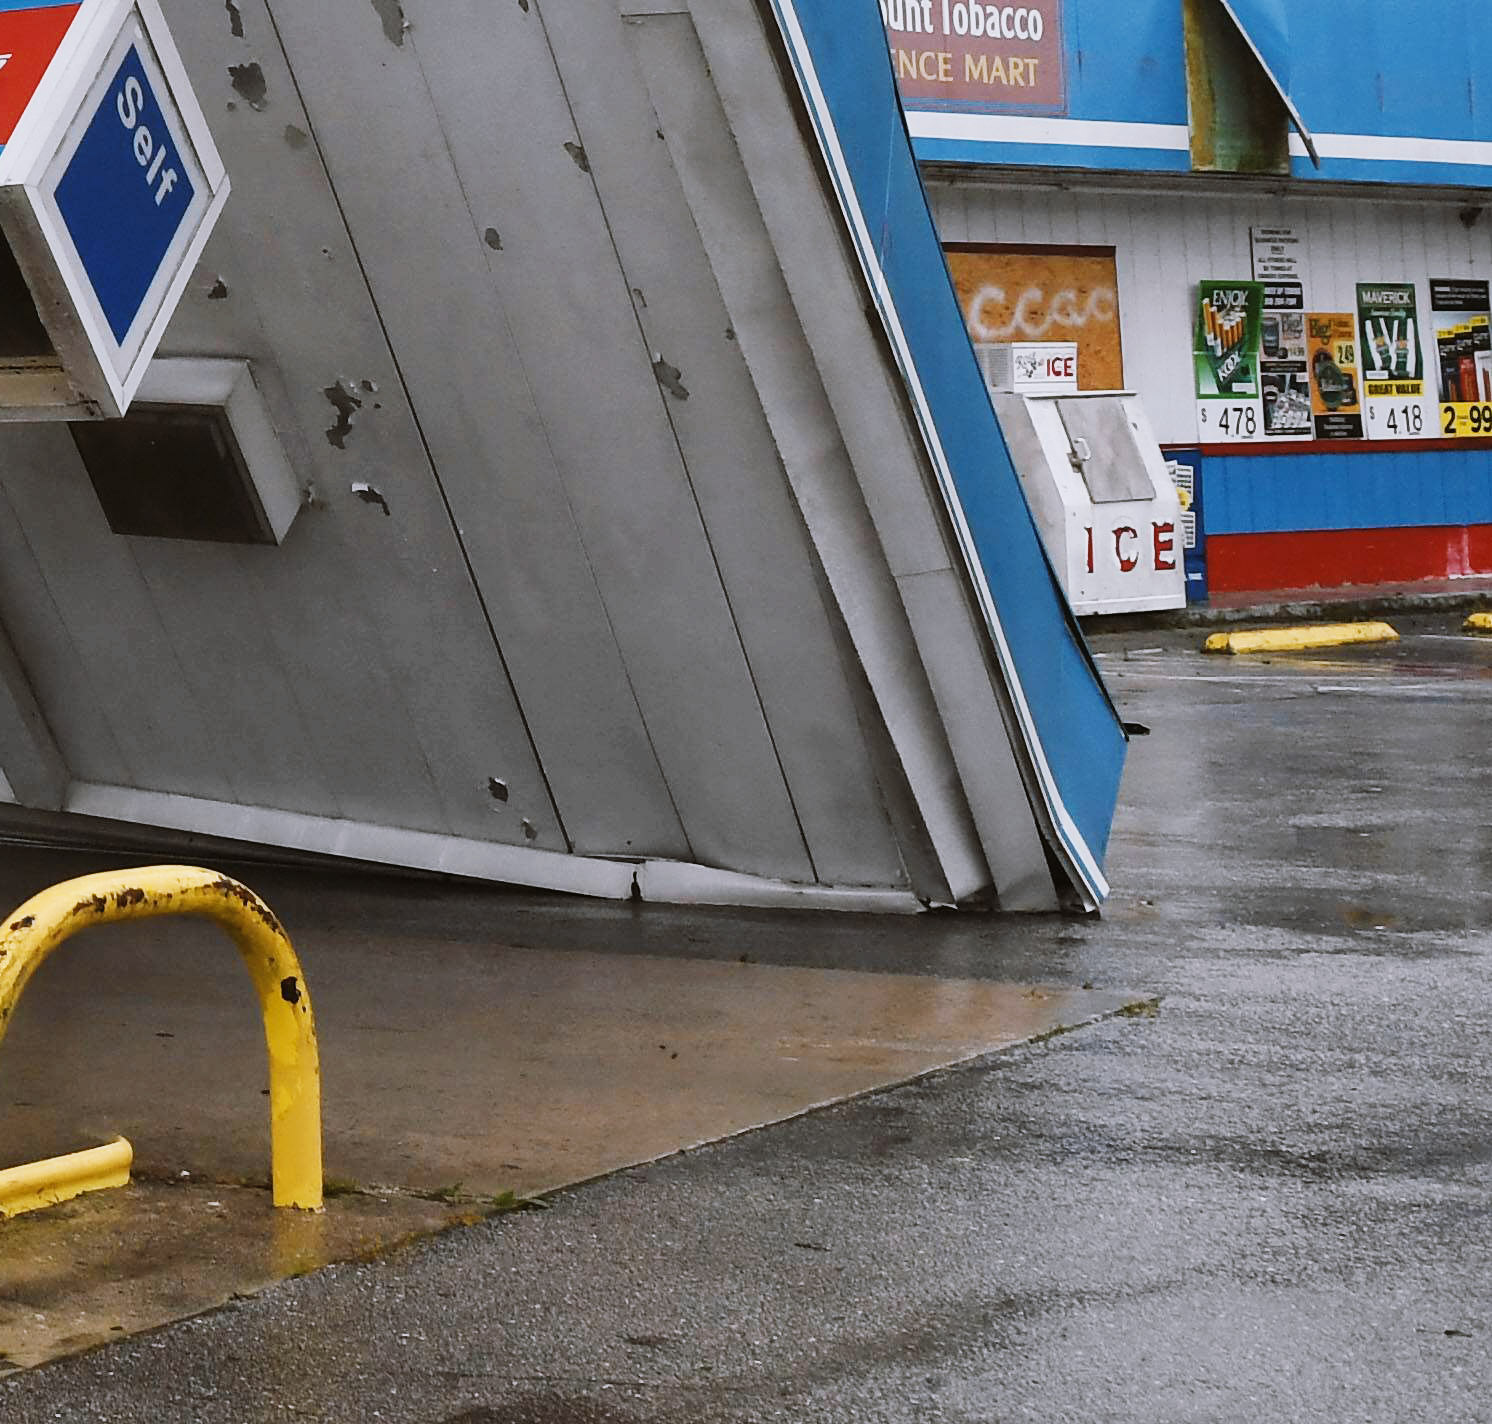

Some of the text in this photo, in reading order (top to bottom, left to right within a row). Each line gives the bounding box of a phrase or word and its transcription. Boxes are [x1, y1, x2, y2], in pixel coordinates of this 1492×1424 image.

[965, 54, 1039, 87] MART
[117, 76, 177, 207] Self
[1362, 290, 1411, 304] MAVERICK
[1046, 357, 1074, 377] ICE
[1443, 405, 1457, 434] 2
[1084, 521, 1176, 574] ICE
